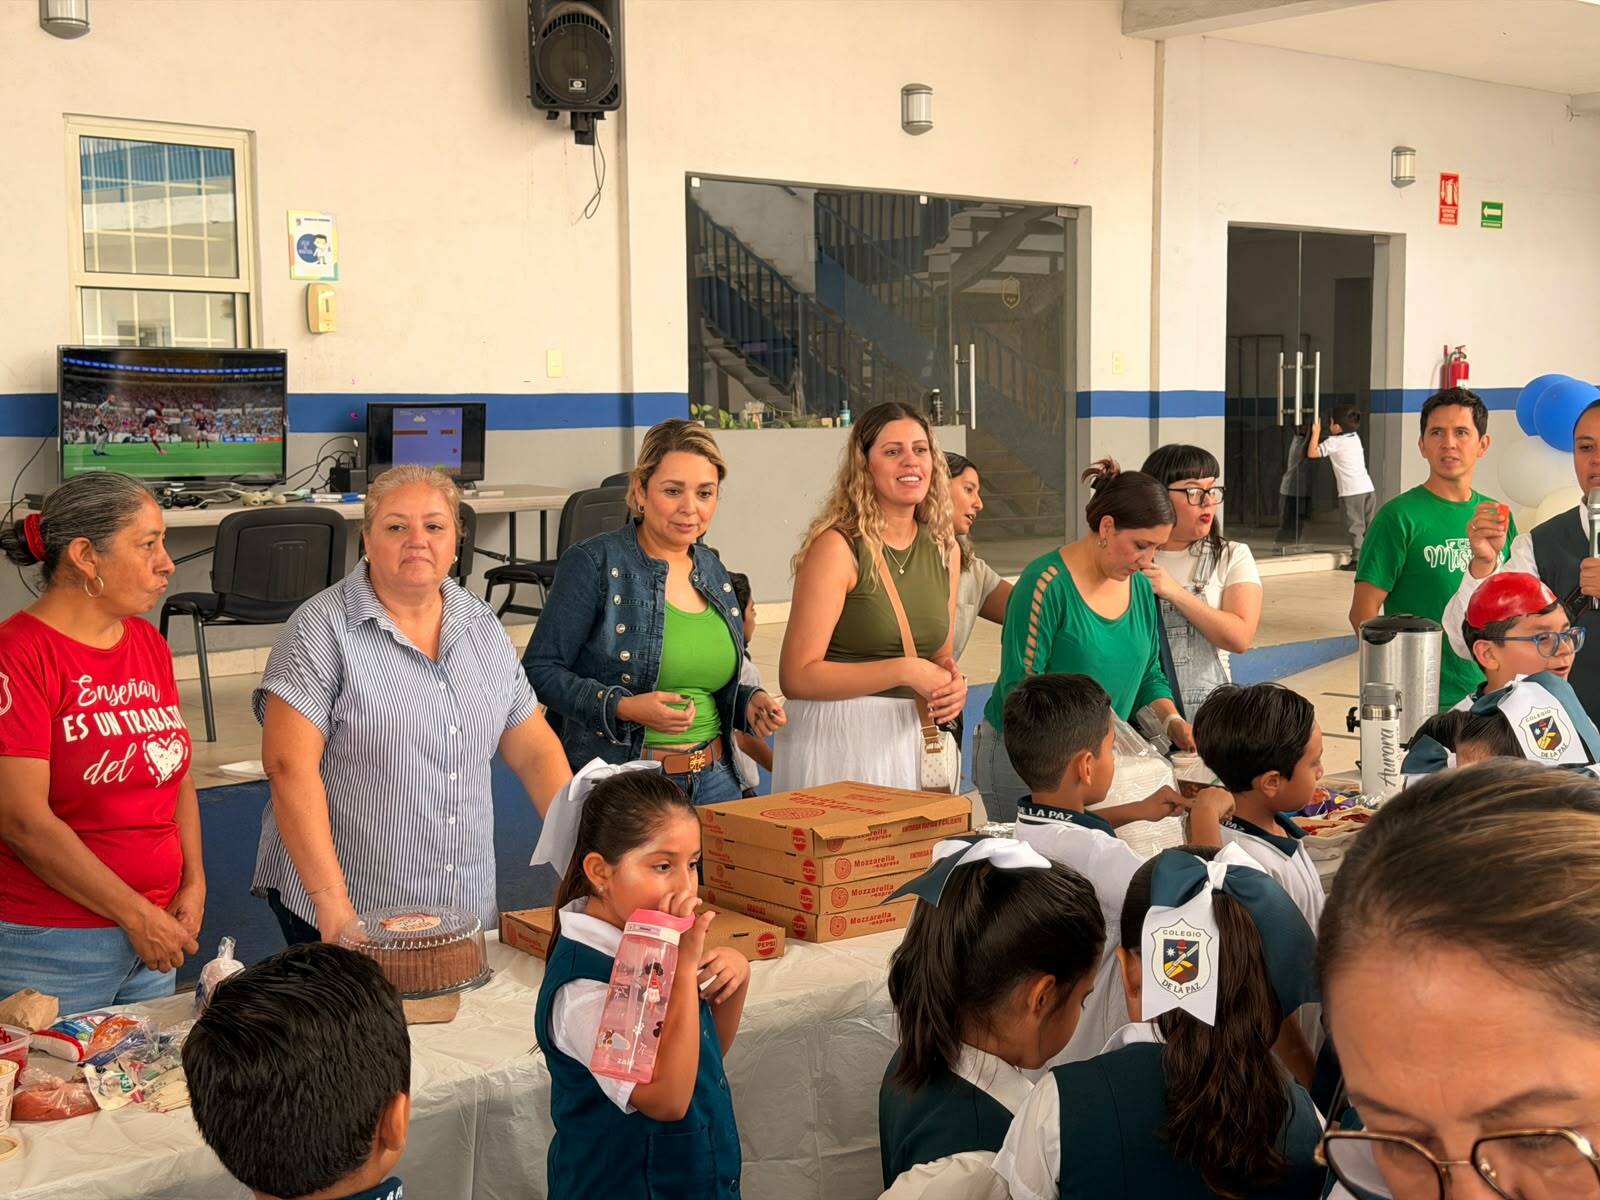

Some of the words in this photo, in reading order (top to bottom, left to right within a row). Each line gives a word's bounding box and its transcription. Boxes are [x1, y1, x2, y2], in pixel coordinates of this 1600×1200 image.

[72, 675, 160, 706] Enseñar
[1526, 709, 1551, 722] COLEGIO
[63, 713, 89, 742] ES
[93, 712, 123, 737] UN
[83, 742, 137, 785] del
[1377, 728, 1398, 787] Aurora
[1029, 808, 1045, 816] LA
[1049, 811, 1073, 821] PAZ
[854, 855, 895, 867] Mozzarella
[851, 884, 894, 896] Mozzarella
[850, 912, 892, 924] Mozzarella
[1162, 929, 1202, 938] COLEGIO
[757, 940, 776, 948] PEPSI
[1161, 979, 1173, 990] DE
[1173, 985, 1184, 994] LA
[1185, 982, 1201, 994] PAZ
